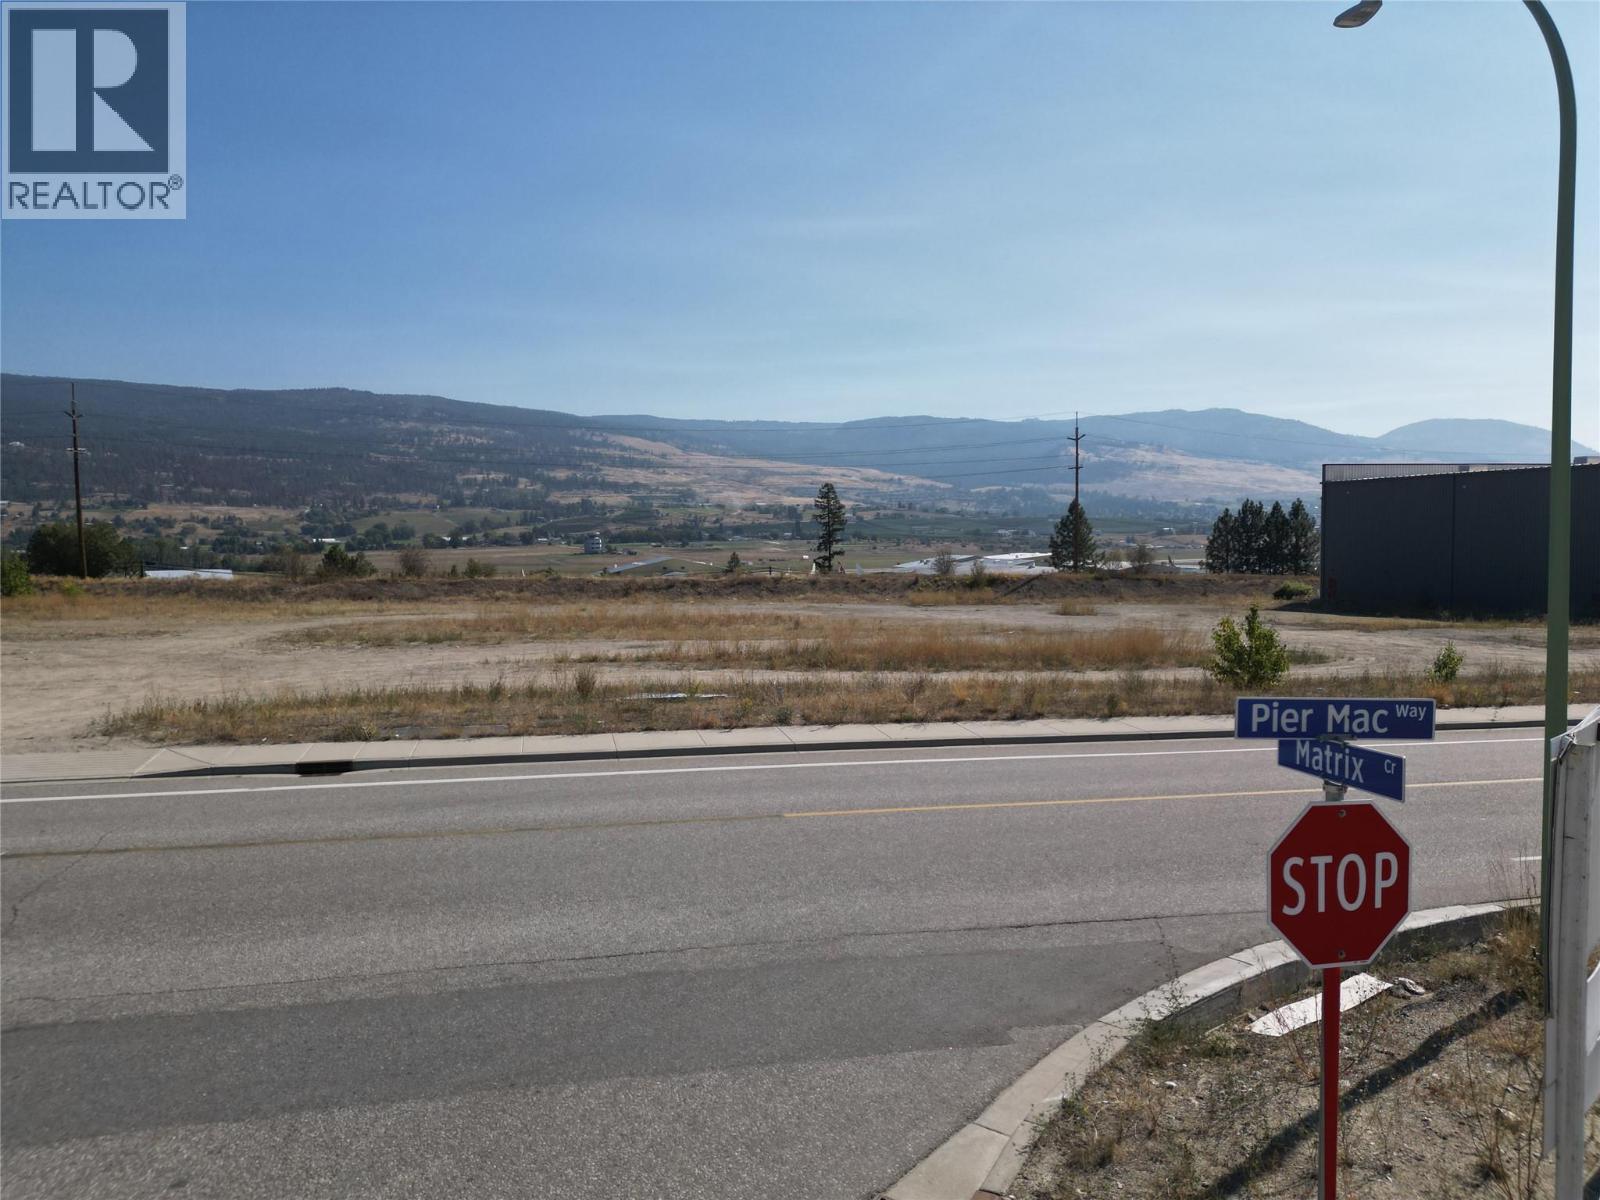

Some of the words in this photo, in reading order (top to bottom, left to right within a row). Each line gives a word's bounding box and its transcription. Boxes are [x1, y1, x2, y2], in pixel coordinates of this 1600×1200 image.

[1251, 702, 1314, 733] Pier
[1327, 704, 1389, 733] Mac
[1395, 704, 1427, 720] Way
[1296, 740, 1365, 783] Matrix
[1384, 759, 1397, 775] Cr
[1282, 851, 1399, 916] STOP
